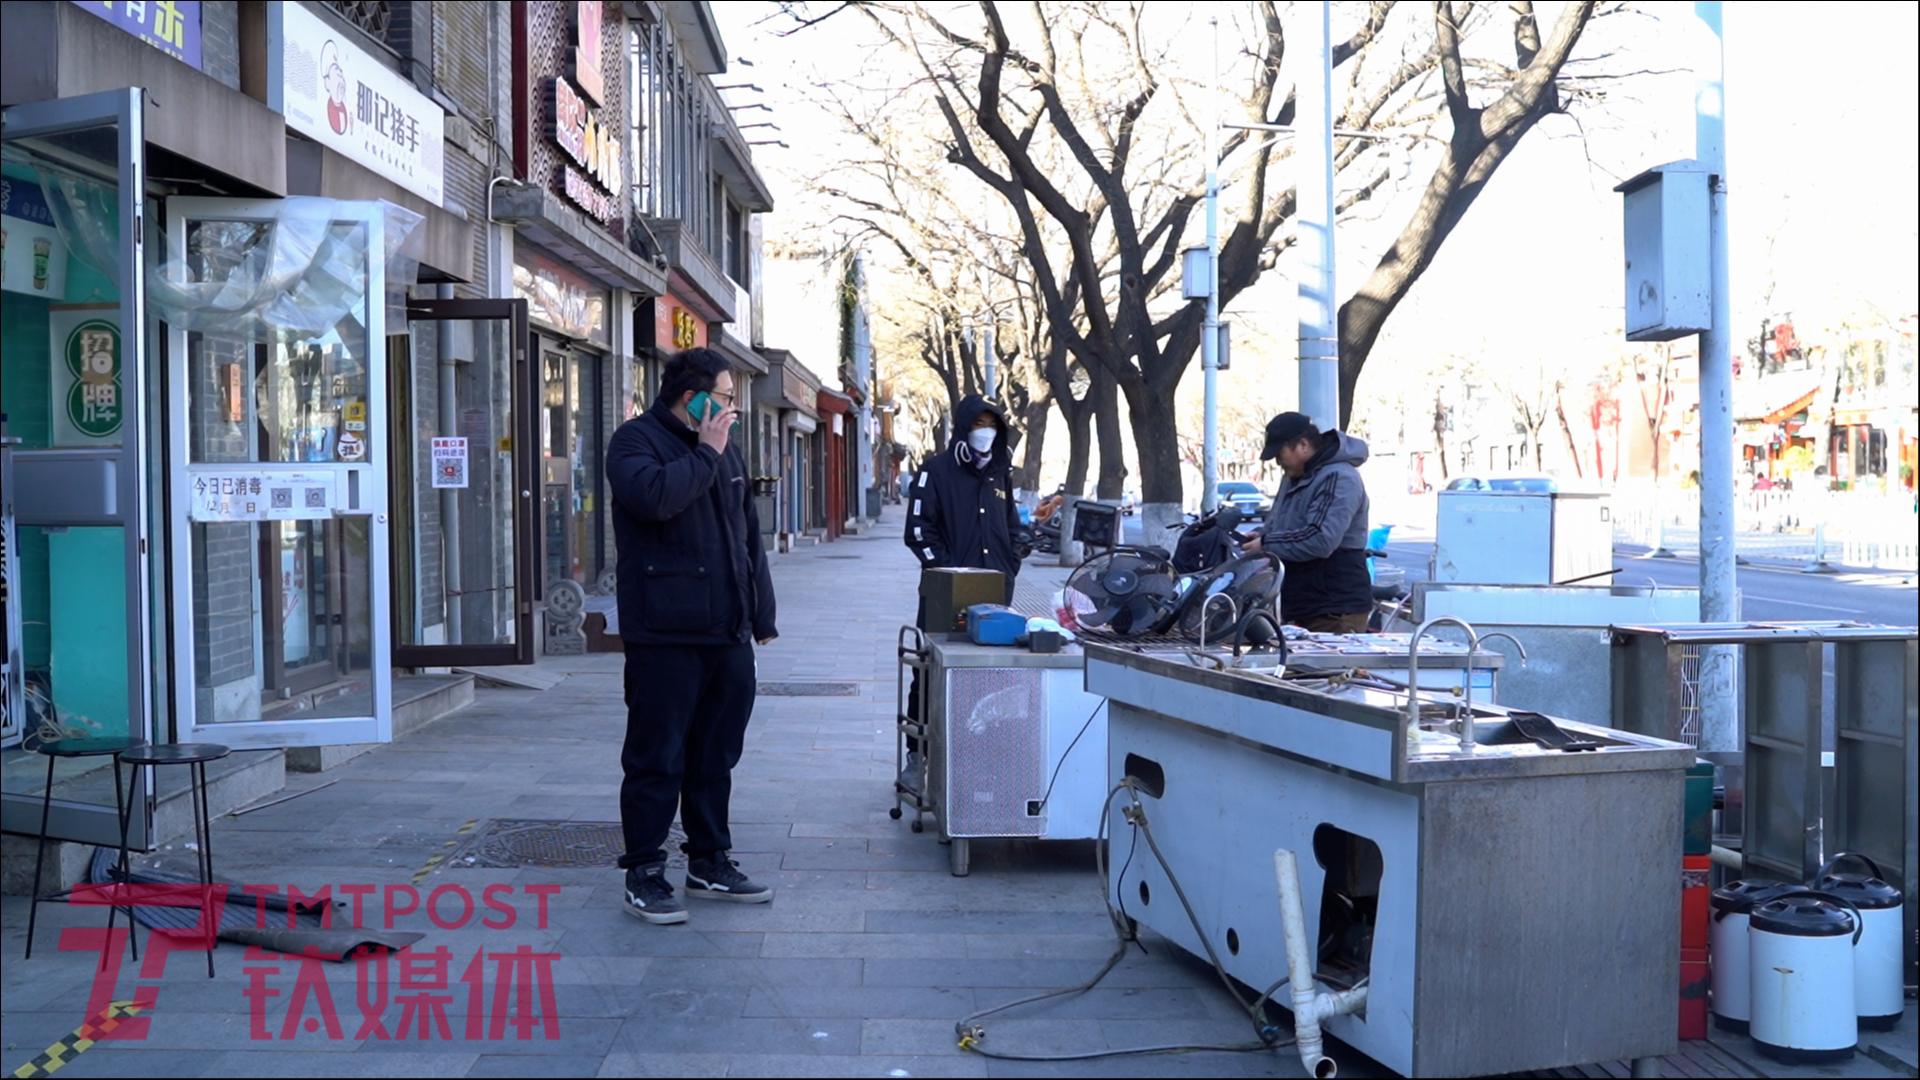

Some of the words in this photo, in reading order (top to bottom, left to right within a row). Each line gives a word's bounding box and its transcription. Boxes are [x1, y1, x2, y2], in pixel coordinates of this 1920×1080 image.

[81, 332, 116, 421] 招牌
[194, 476, 262, 496] 今日已消毒
